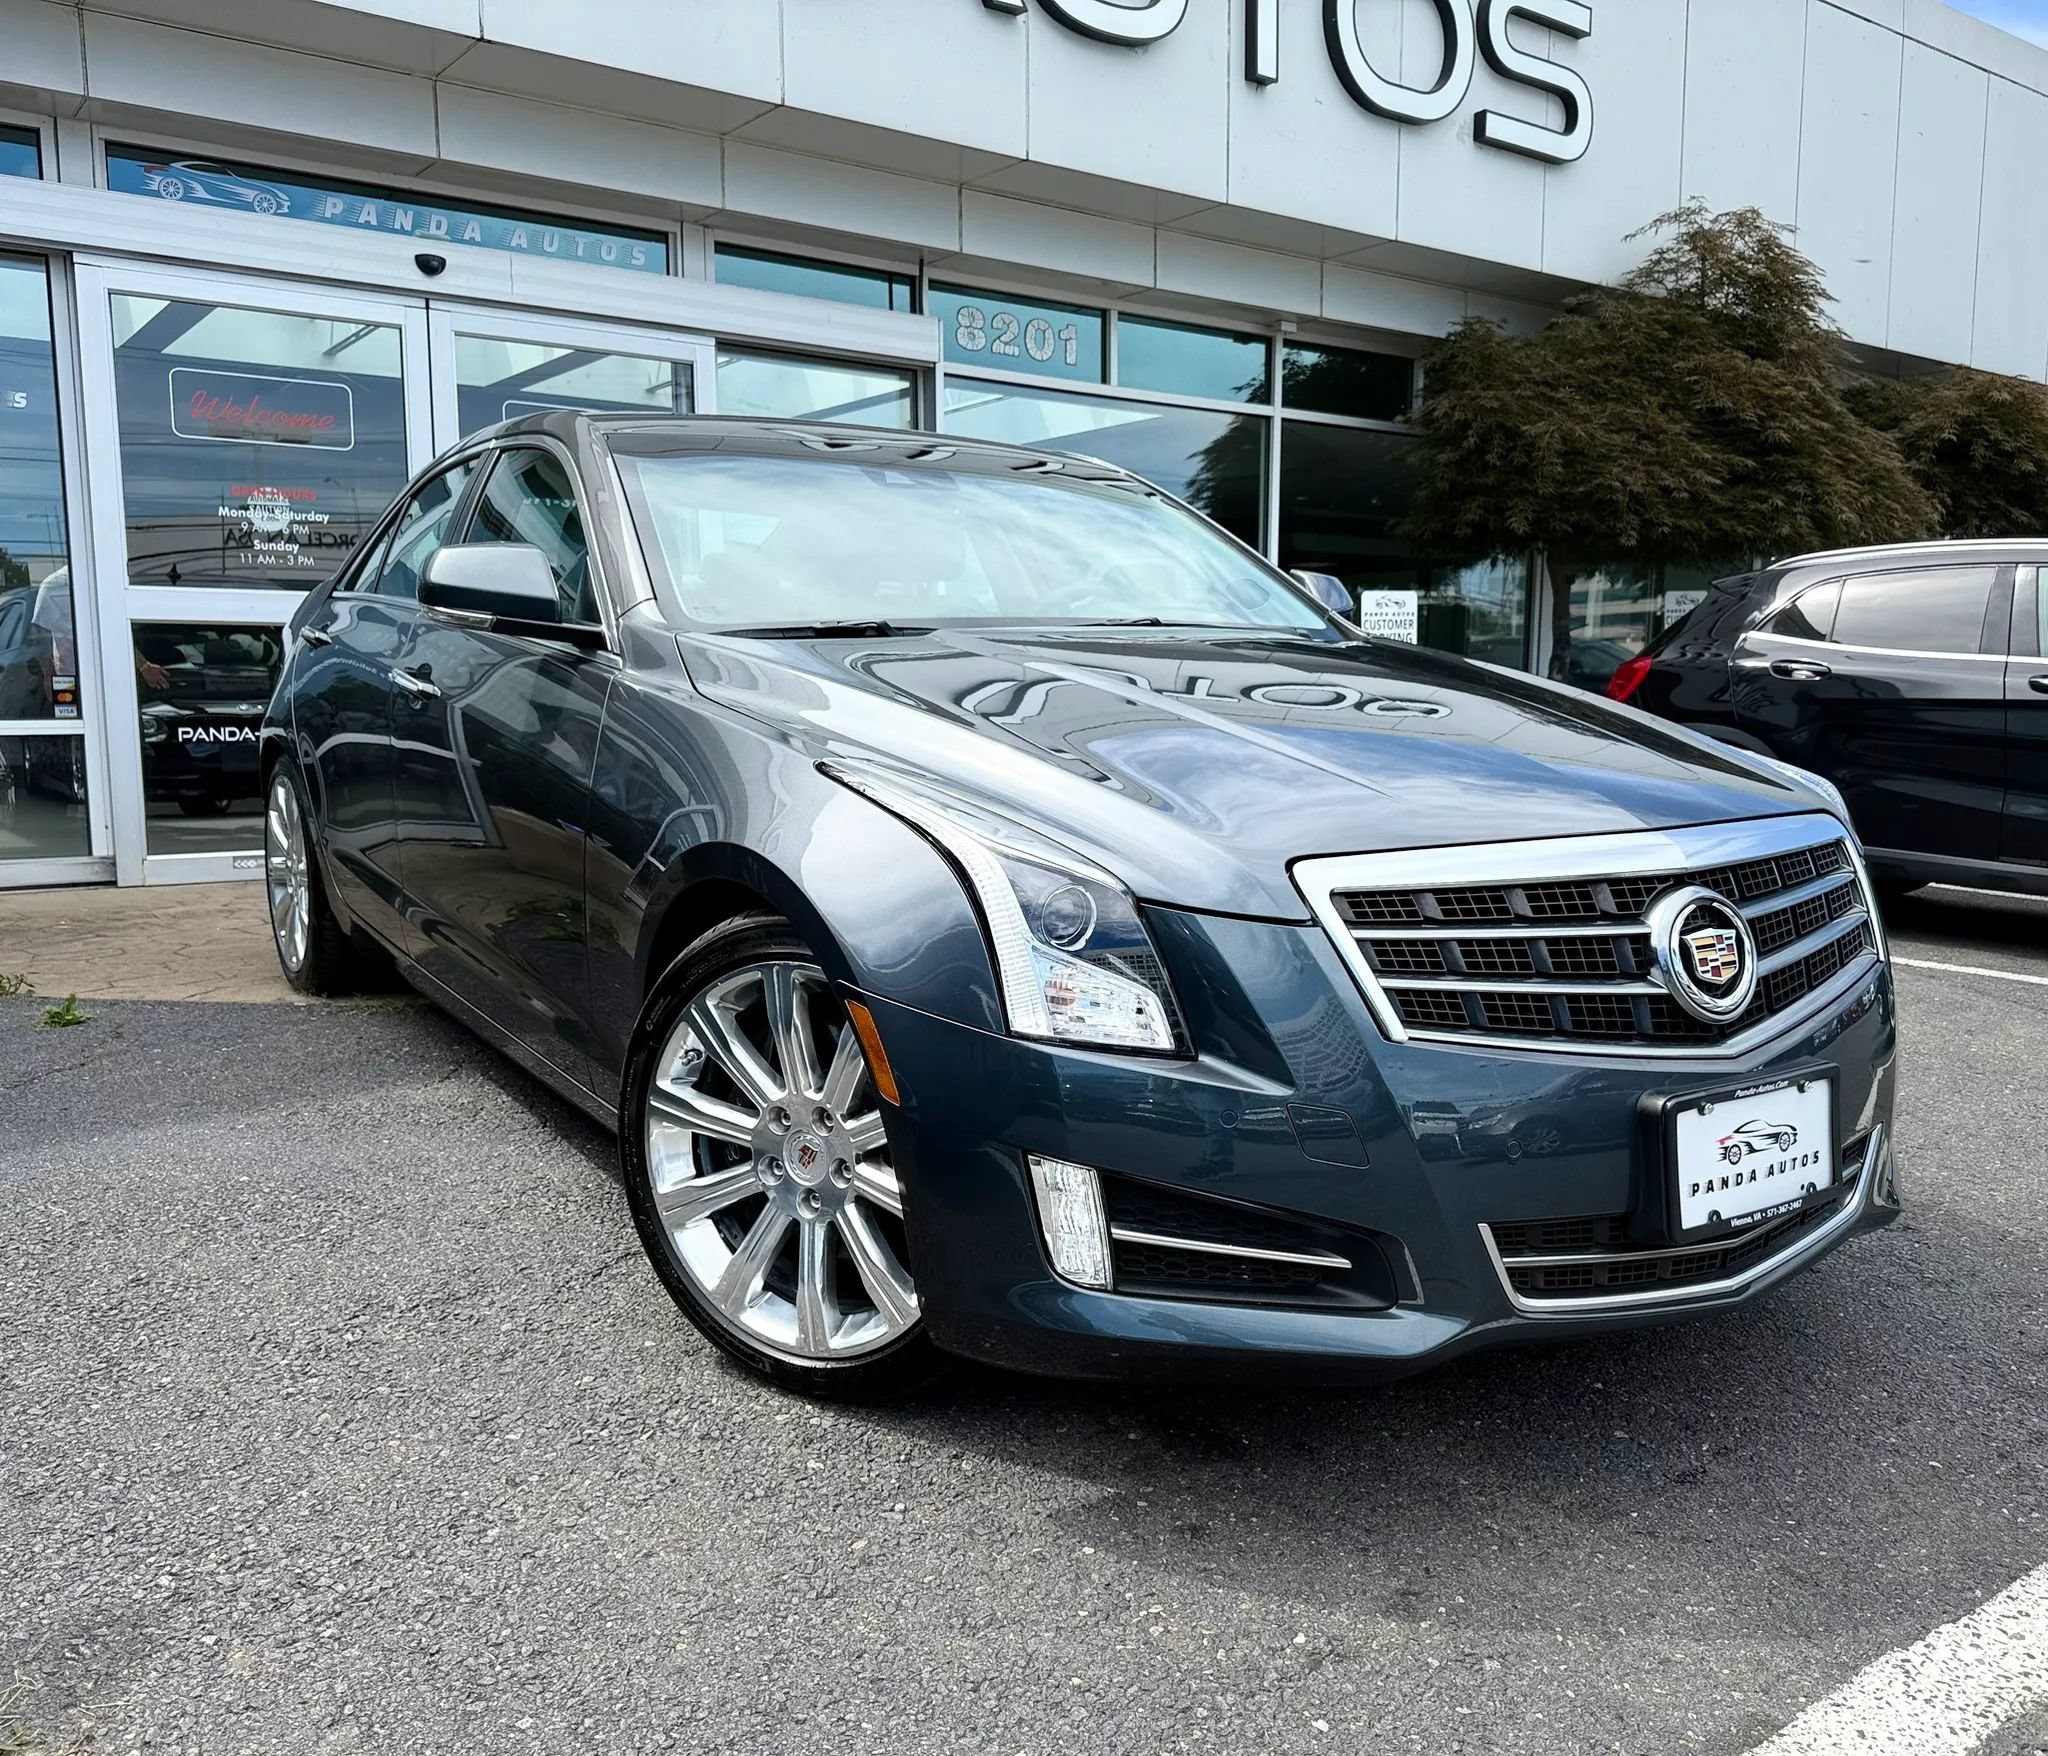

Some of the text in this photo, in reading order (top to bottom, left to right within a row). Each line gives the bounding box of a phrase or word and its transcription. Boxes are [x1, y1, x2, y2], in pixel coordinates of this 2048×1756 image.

[324, 196, 646, 266] PANDA AUTOS
[955, 305, 1078, 366] 8201
[191, 390, 335, 431] Welcome
[241, 523, 247, 533] 9
[282, 526, 290, 535] 6
[293, 525, 309, 535] PM
[253, 539, 300, 555] Sunday
[240, 553, 252, 564] 11
[257, 555, 276, 565] AM
[288, 555, 295, 566] 3
[298, 556, 315, 567] PM
[1363, 619, 1415, 631] CUSTOMER
[1691, 1150, 1819, 1197] PANDA AUTOS
[1753, 1211, 1762, 1222] VA
